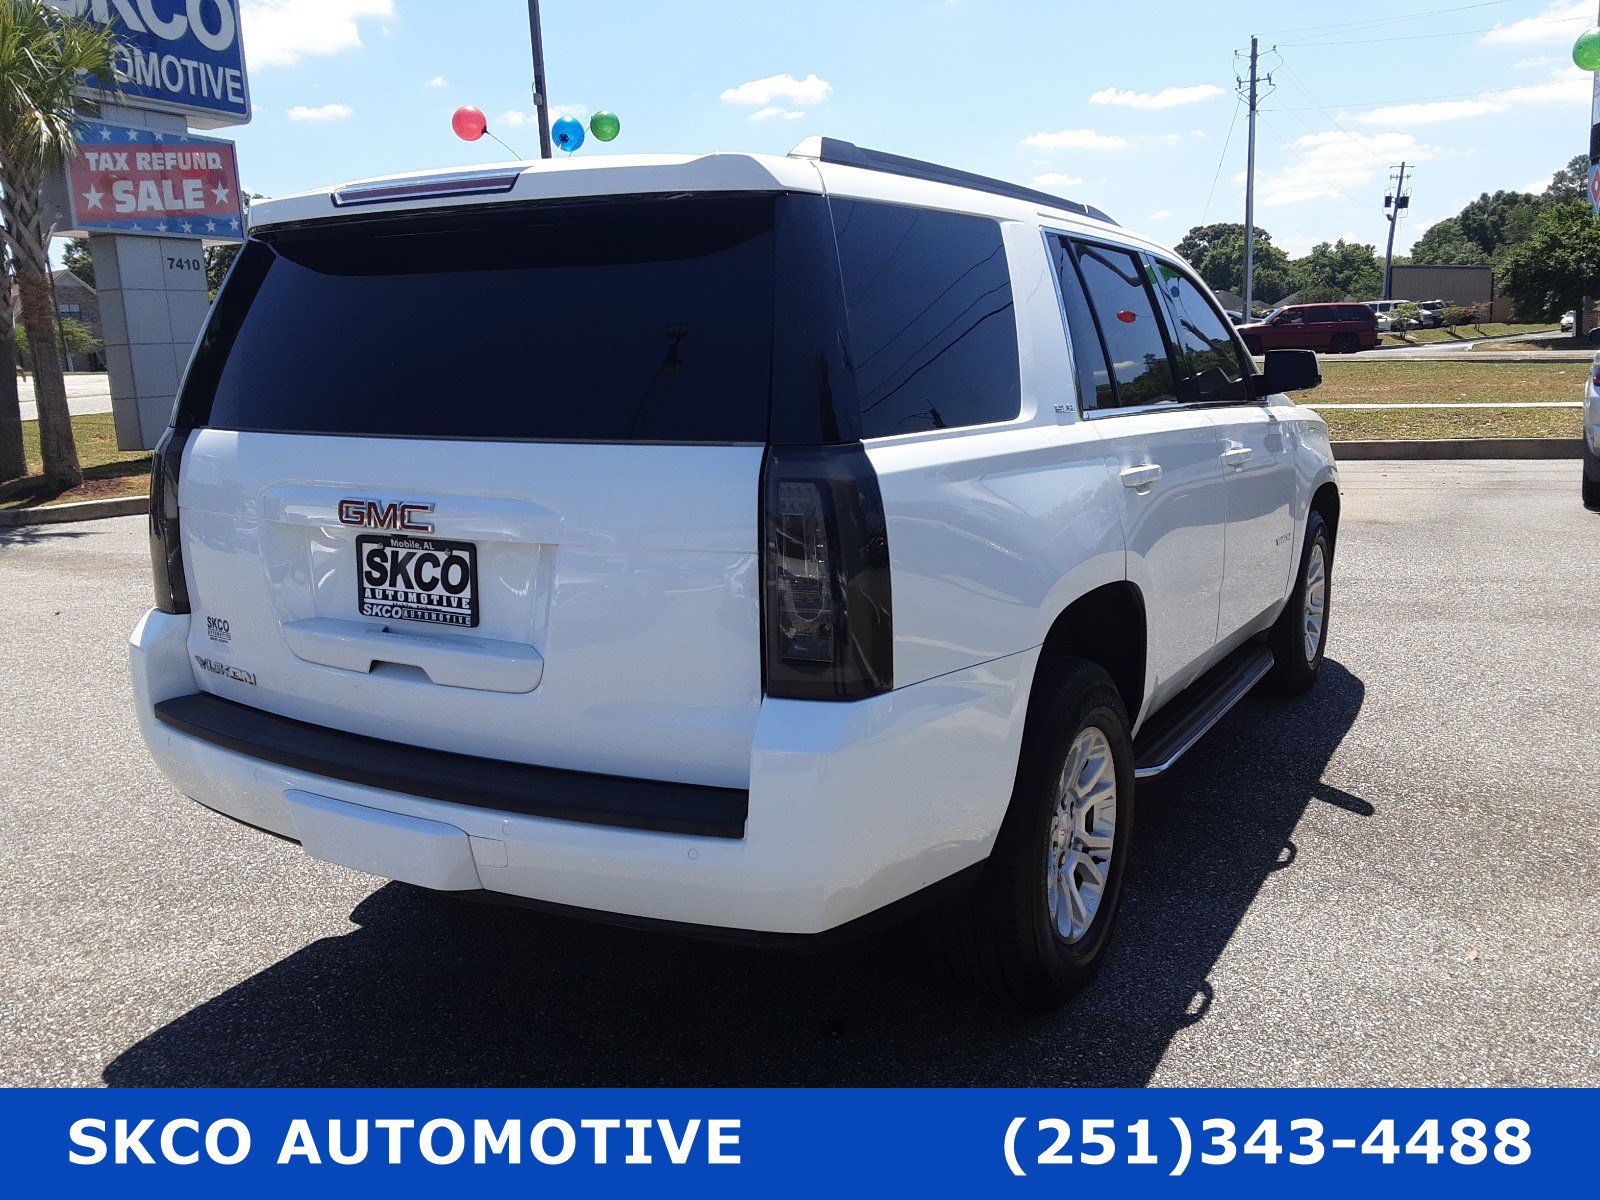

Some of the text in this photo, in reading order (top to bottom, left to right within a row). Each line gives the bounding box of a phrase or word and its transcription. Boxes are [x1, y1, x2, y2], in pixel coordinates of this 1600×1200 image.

[72, 42, 245, 104] OMOTIVE
[85, 152, 222, 172] TAX REFUND
[112, 178, 206, 213] SALE
[166, 257, 200, 271] 7410
[338, 499, 435, 533] GMC
[390, 538, 435, 551] Mobile, AL
[364, 548, 470, 596] SKCO
[364, 587, 470, 609] AUTOMOTIVE
[362, 603, 402, 619] SKCO
[402, 608, 471, 626] AUTOMOTIVE
[206, 616, 230, 633] SKCO
